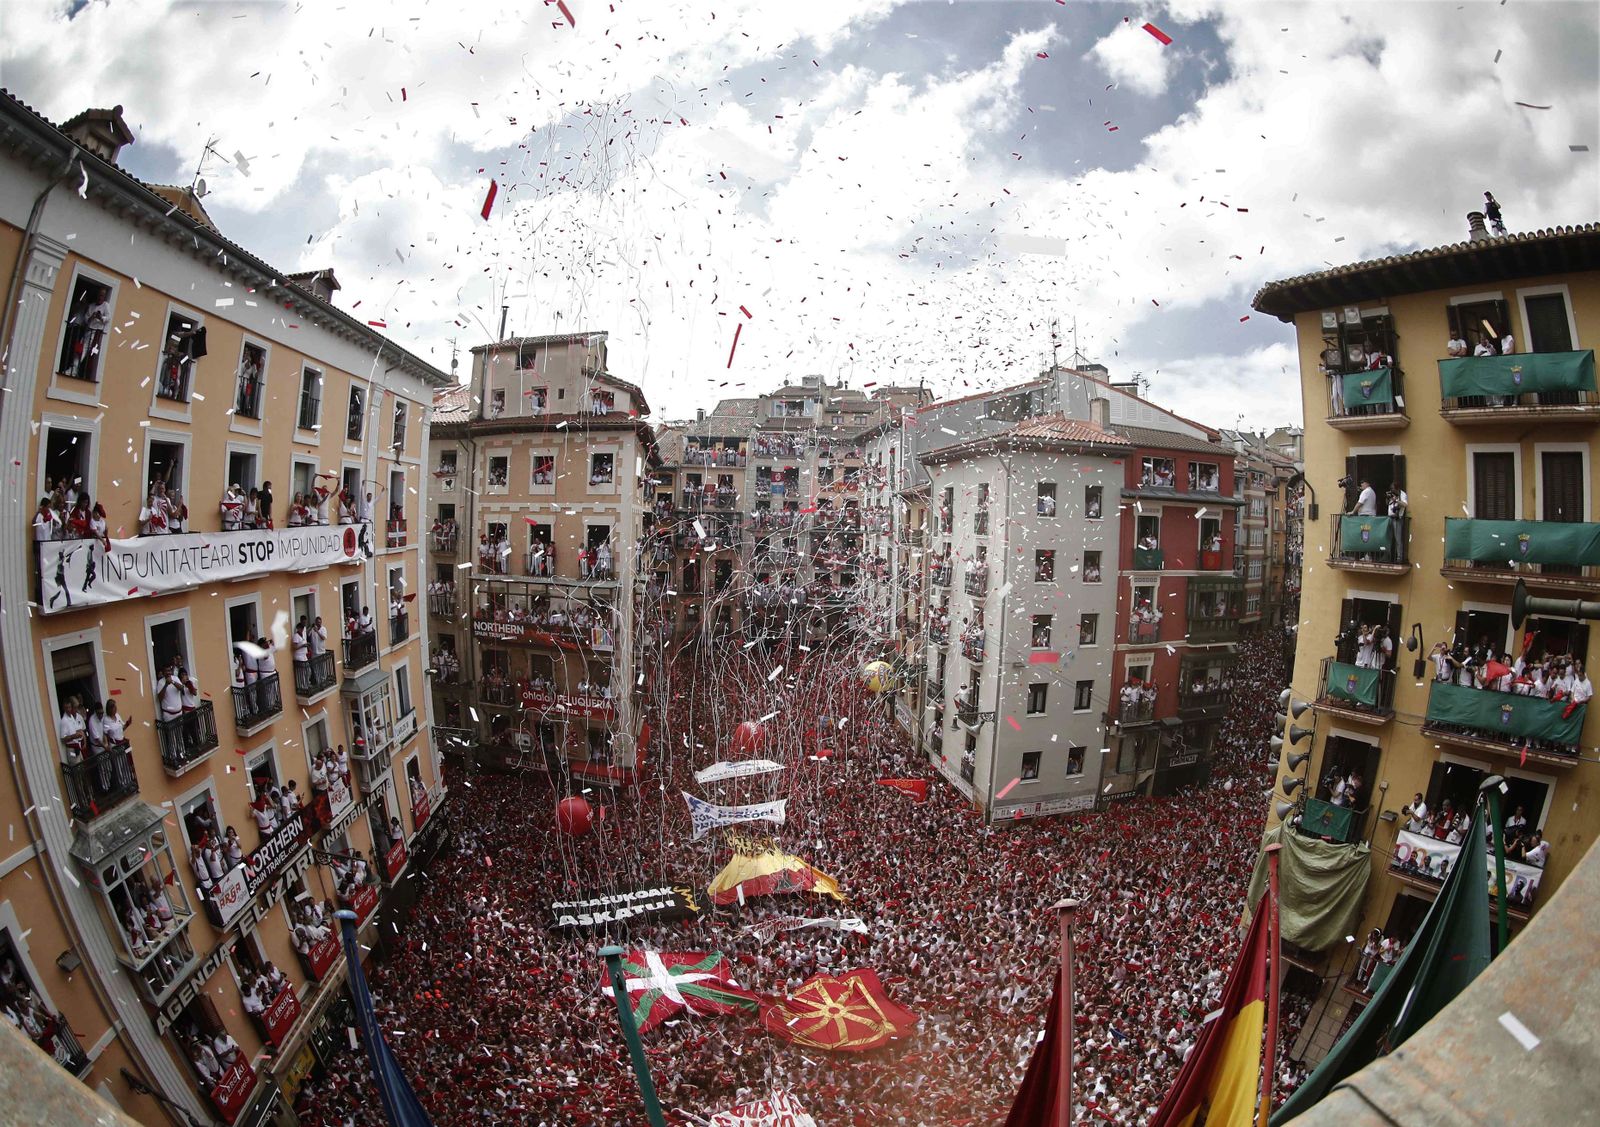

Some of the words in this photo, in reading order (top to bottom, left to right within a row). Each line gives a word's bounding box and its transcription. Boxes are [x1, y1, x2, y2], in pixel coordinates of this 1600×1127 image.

[101, 544, 234, 582] INPUNITATEARI
[238, 541, 274, 564] STOP
[278, 534, 340, 559] IMPUNIDAD
[473, 621, 524, 635] NORTHERN
[243, 816, 304, 881] NORTHERN
[249, 871, 267, 891] SPAIN
[266, 842, 299, 875] TRAVEL.com
[552, 886, 675, 908] ALTSASUKOAK
[156, 944, 231, 1037] AGENCIA
[238, 849, 314, 938] ELIZARI
[275, 992, 292, 1018] EROSKI
[227, 1064, 246, 1093] EROKI
